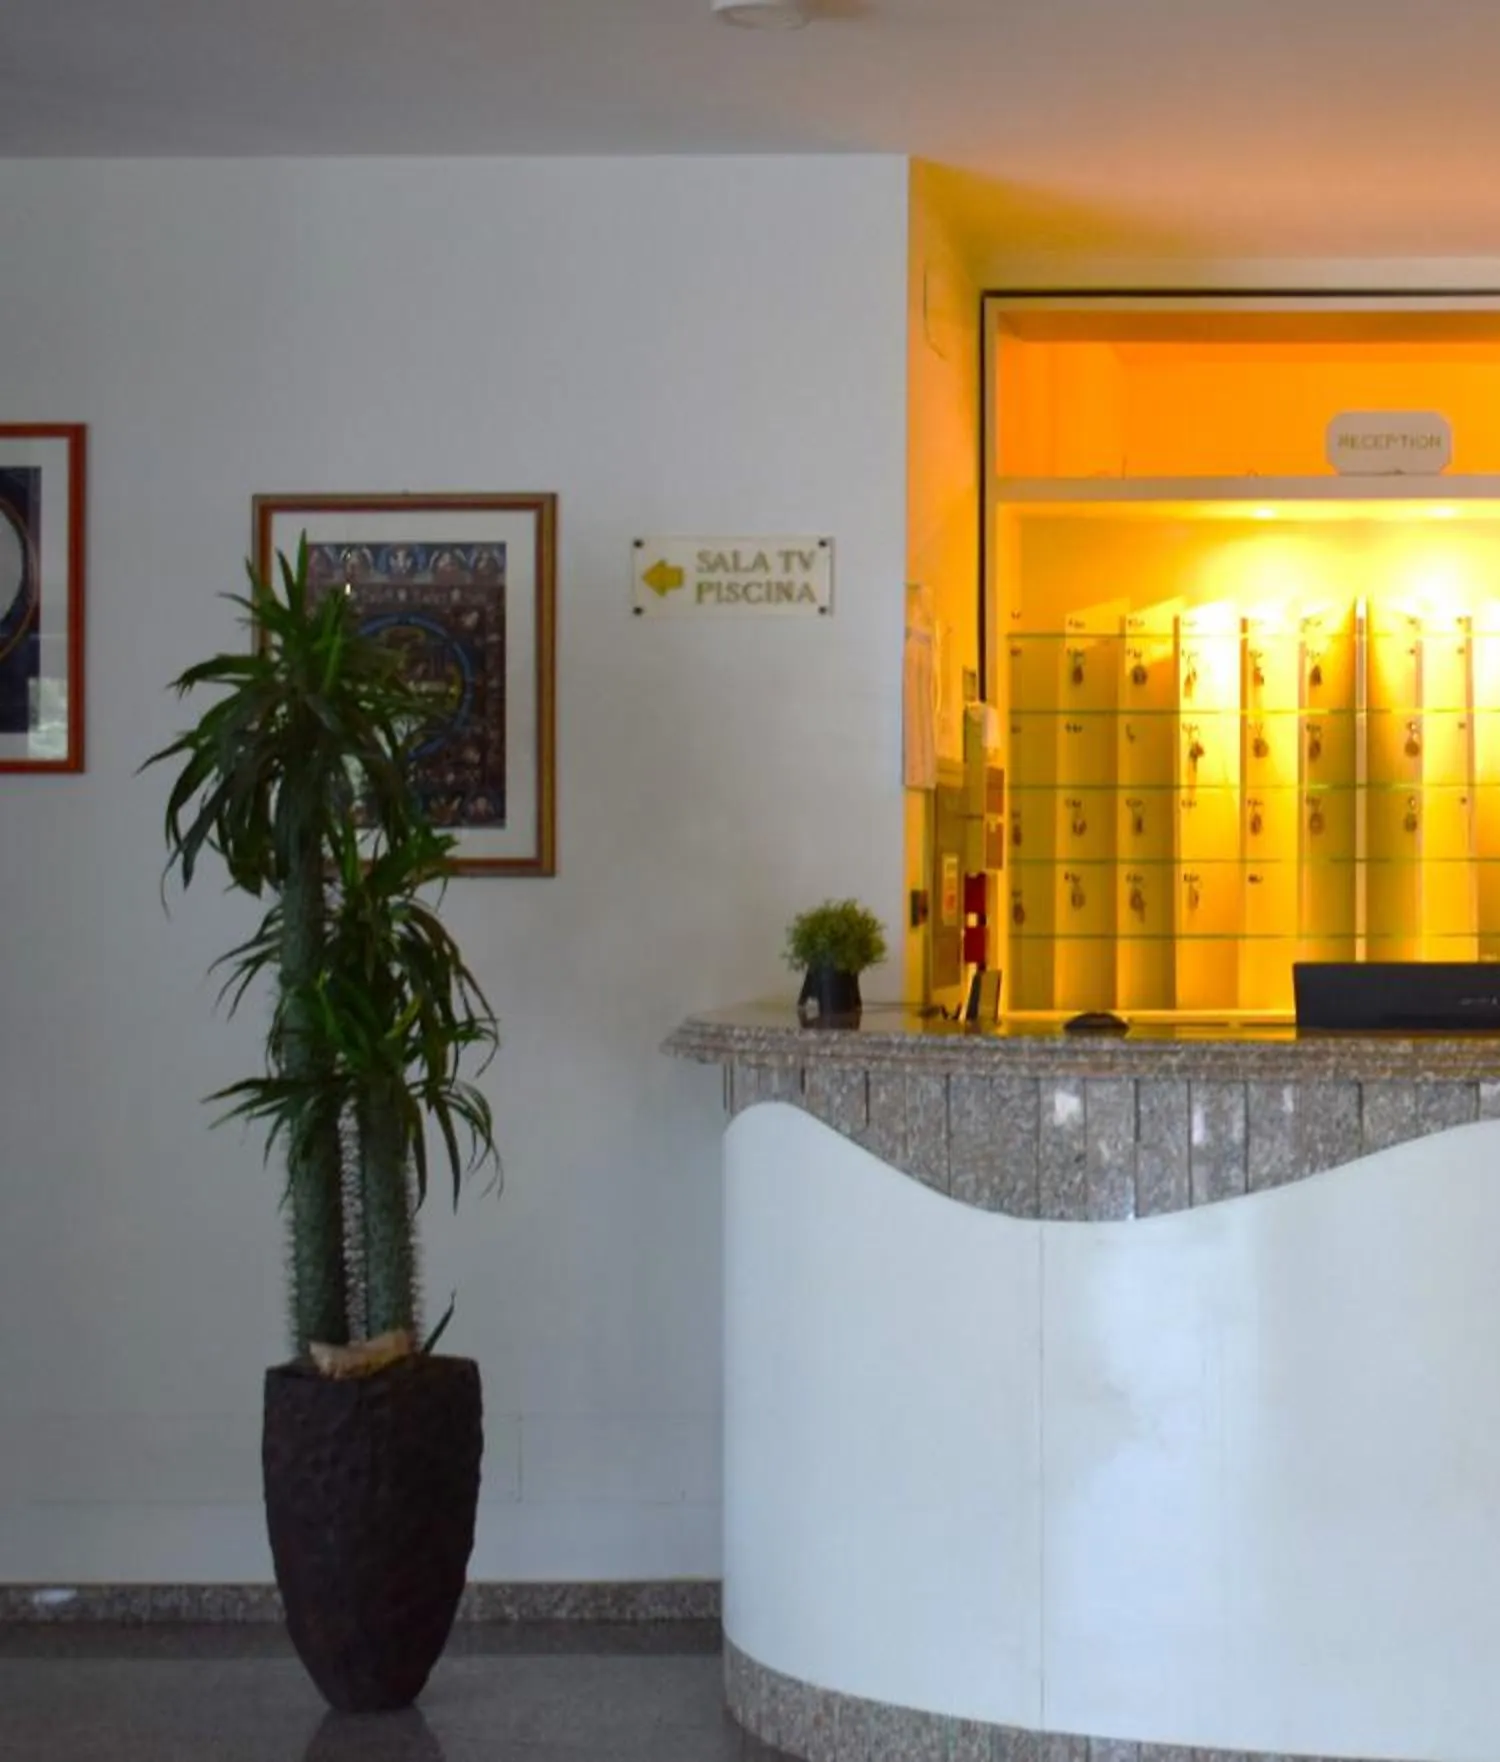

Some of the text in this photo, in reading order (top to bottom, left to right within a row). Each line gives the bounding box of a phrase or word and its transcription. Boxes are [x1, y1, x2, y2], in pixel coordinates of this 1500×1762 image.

[1337, 432, 1441, 450] RECEPTION
[696, 549, 816, 574] SALA TV
[695, 581, 817, 604] PISCINA
